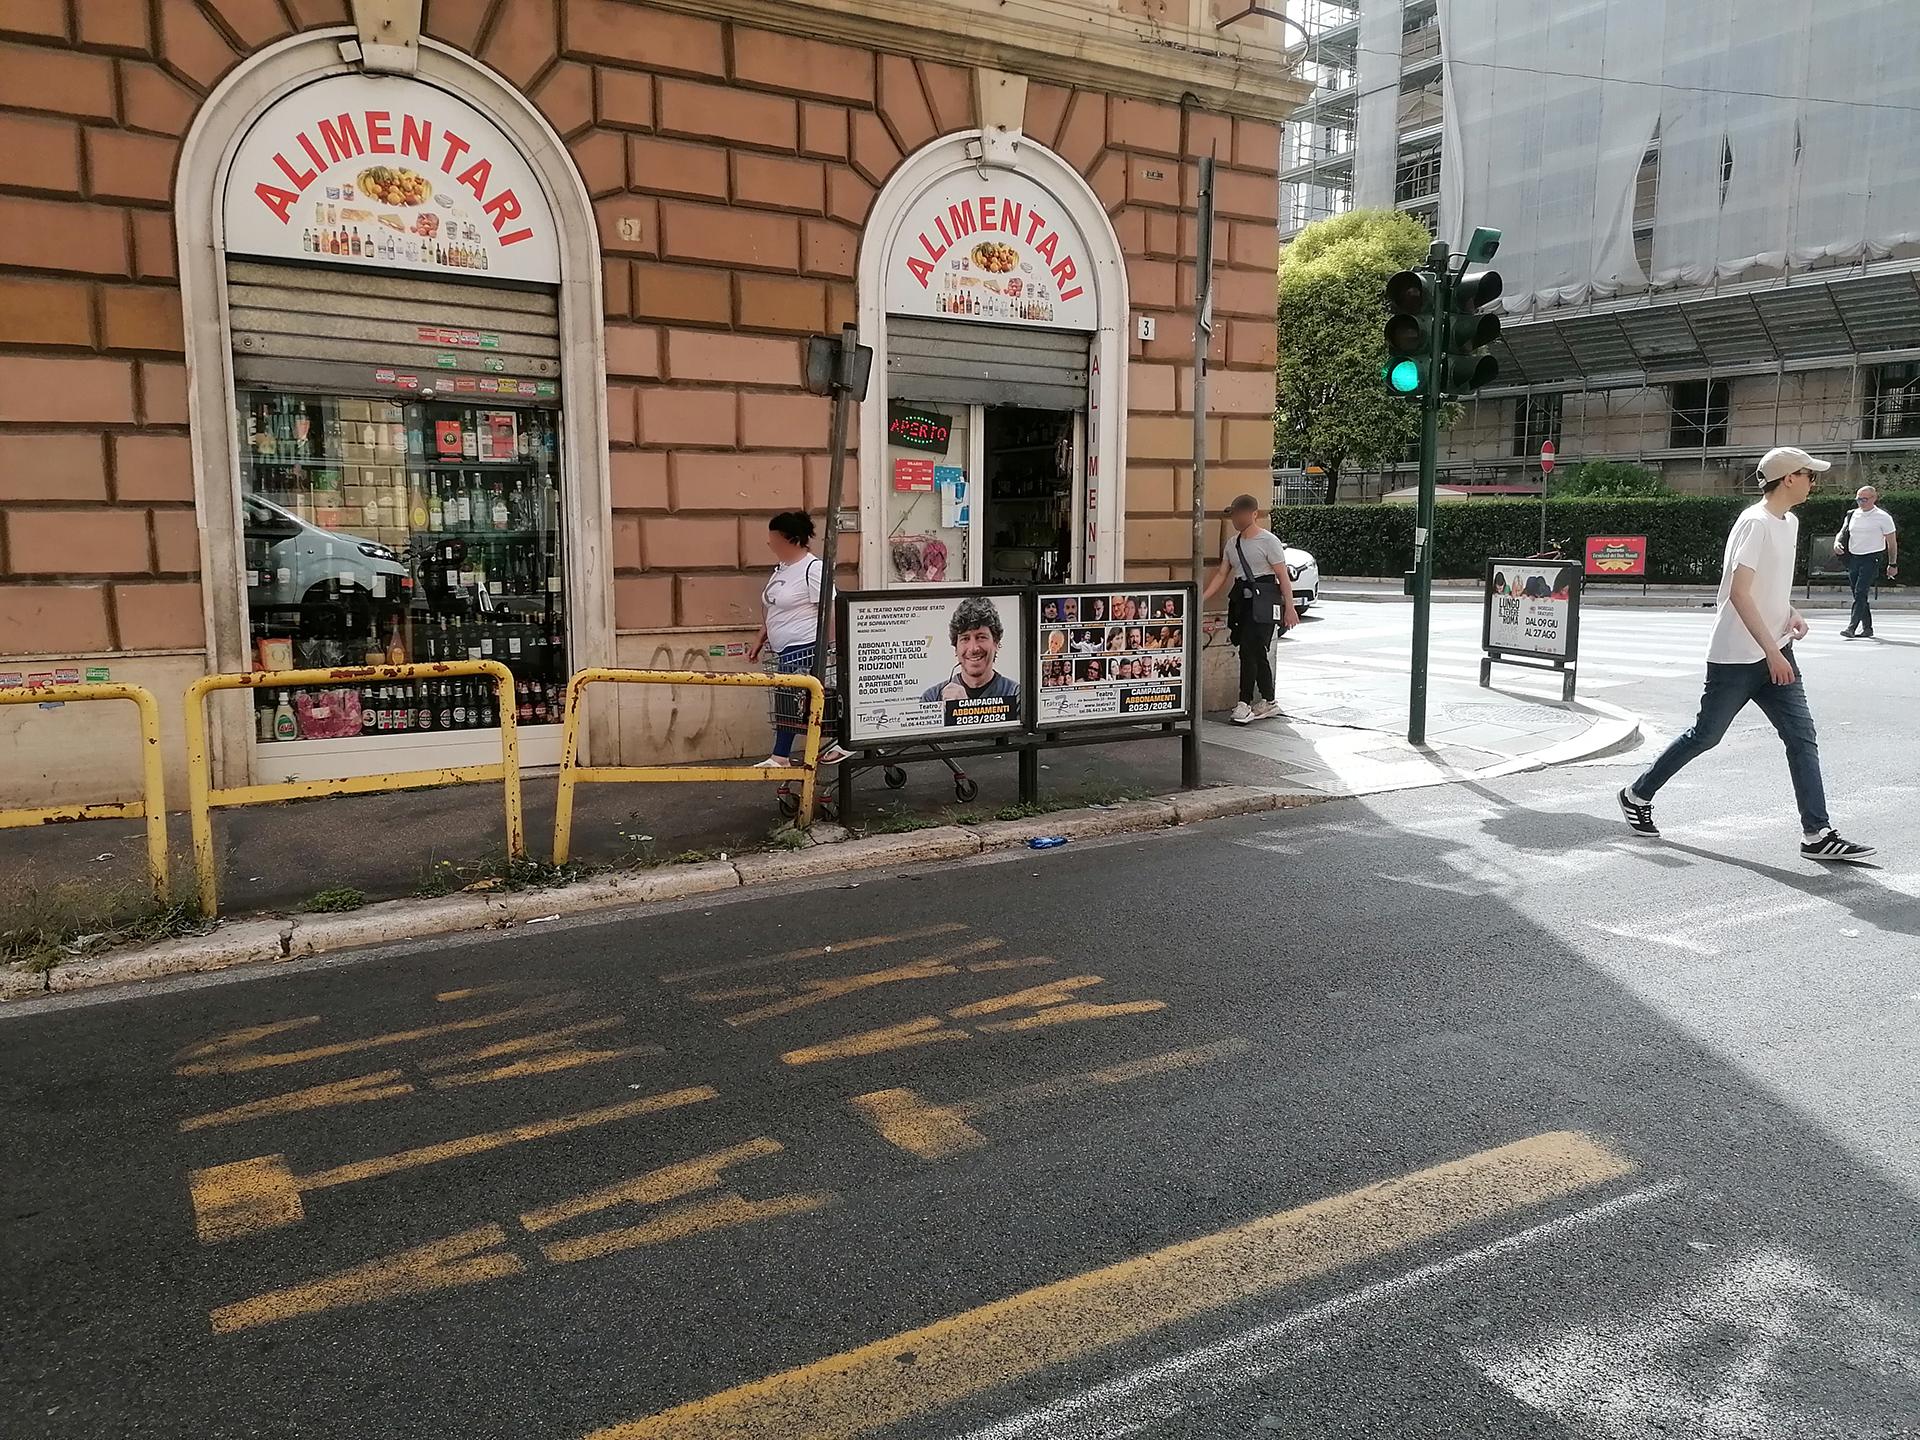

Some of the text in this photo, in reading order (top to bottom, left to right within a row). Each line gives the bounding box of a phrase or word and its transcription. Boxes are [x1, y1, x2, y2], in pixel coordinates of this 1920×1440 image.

[254, 110, 534, 247] ALIMENTARI
[622, 217, 633, 236] 5
[906, 196, 1084, 303] ALIMENTARI
[1144, 320, 1150, 336] 3
[889, 418, 948, 442] APERTO
[1499, 598, 1520, 609] LUNGO
[1503, 616, 1519, 625] ROMA
[1526, 618, 1558, 628] DAL 09 GIU
[1525, 628, 1532, 637] AL
[1534, 629, 1541, 638] 27
[1542, 631, 1556, 639] AGO
[858, 641, 890, 649] ABBONATI
[868, 654, 907, 662] APPROFITTA
[858, 662, 904, 671] RIDUZIONI!
[859, 674, 906, 682] ABBONAMENTI
[1131, 687, 1170, 696] CAMPAGNA
[958, 697, 1003, 707] CAMPAGNA
[1126, 695, 1176, 704] ABBONAMENTI
[952, 705, 1010, 716] ABBONAMENTI
[1129, 702, 1172, 712] 2023/2024
[956, 714, 1006, 725] 2023/2024
